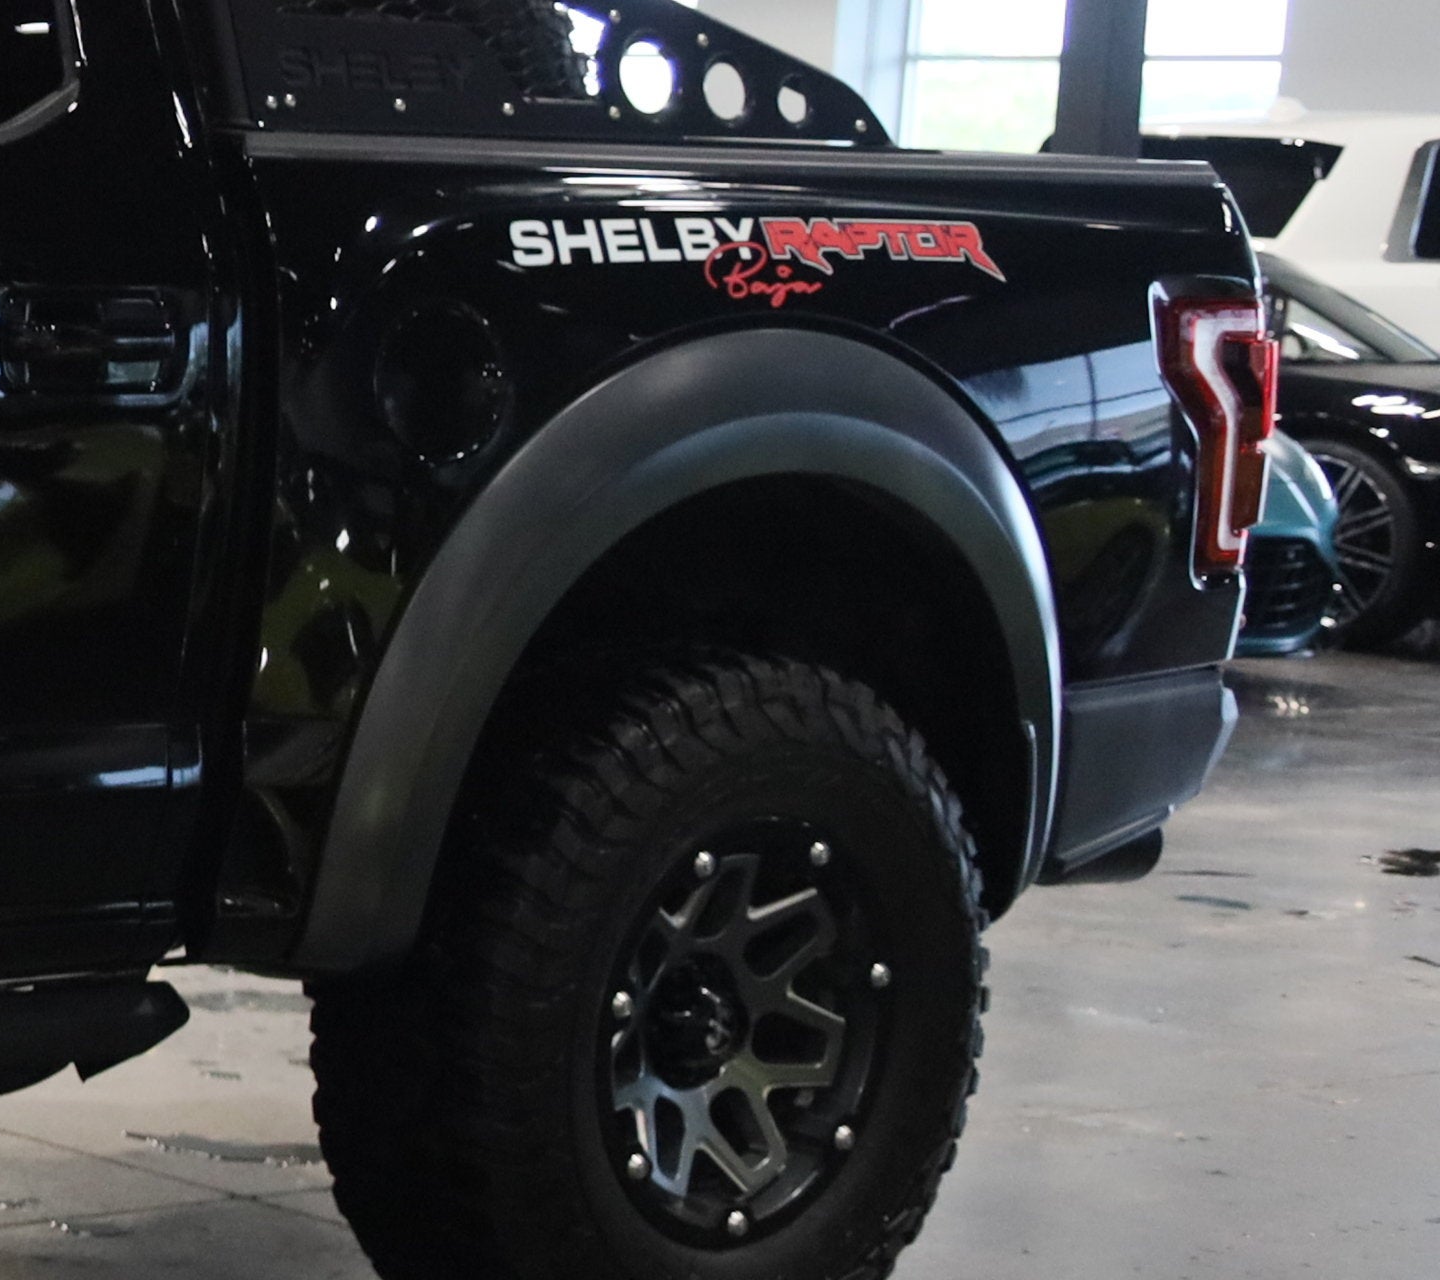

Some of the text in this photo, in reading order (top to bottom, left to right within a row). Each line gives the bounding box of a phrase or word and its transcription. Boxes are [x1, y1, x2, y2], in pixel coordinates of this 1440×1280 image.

[508, 216, 1007, 283] SHELBY RAPTOR
[703, 241, 823, 307] Baja
